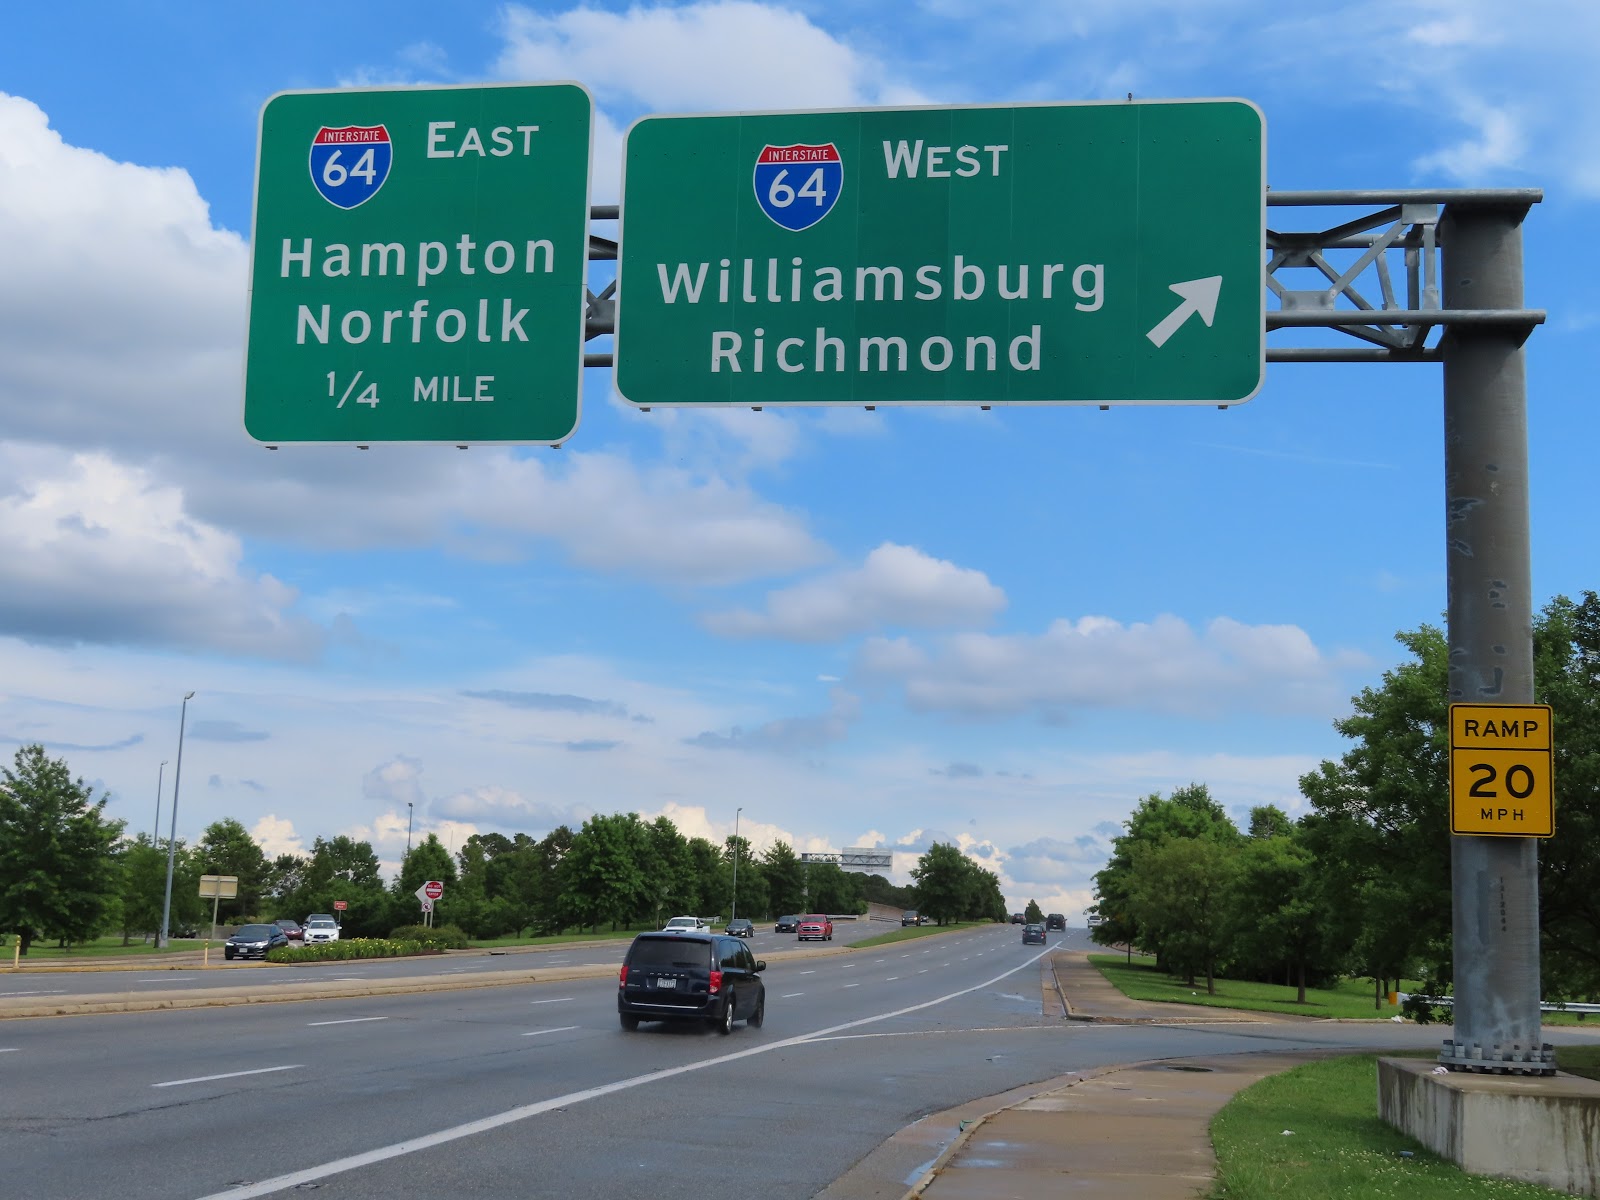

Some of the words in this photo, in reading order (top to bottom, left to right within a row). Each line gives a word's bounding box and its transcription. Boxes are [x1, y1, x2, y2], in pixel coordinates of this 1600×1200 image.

[324, 130, 380, 142] INTERSTATE
[427, 121, 540, 159] EAST
[768, 149, 829, 162] INTERSTATE
[323, 148, 377, 187] 64
[882, 139, 1009, 179] WEST
[768, 167, 827, 208] 64
[280, 234, 554, 287] Hampton
[656, 255, 1105, 312] Williamsburg
[296, 298, 530, 345] Norfolk
[711, 324, 1041, 373] Richmond
[326, 370, 380, 409] 1/4
[413, 375, 495, 402] MILE
[1464, 719, 1539, 738] RAMP
[1468, 763, 1535, 800] 20
[1480, 807, 1524, 821] MPH
